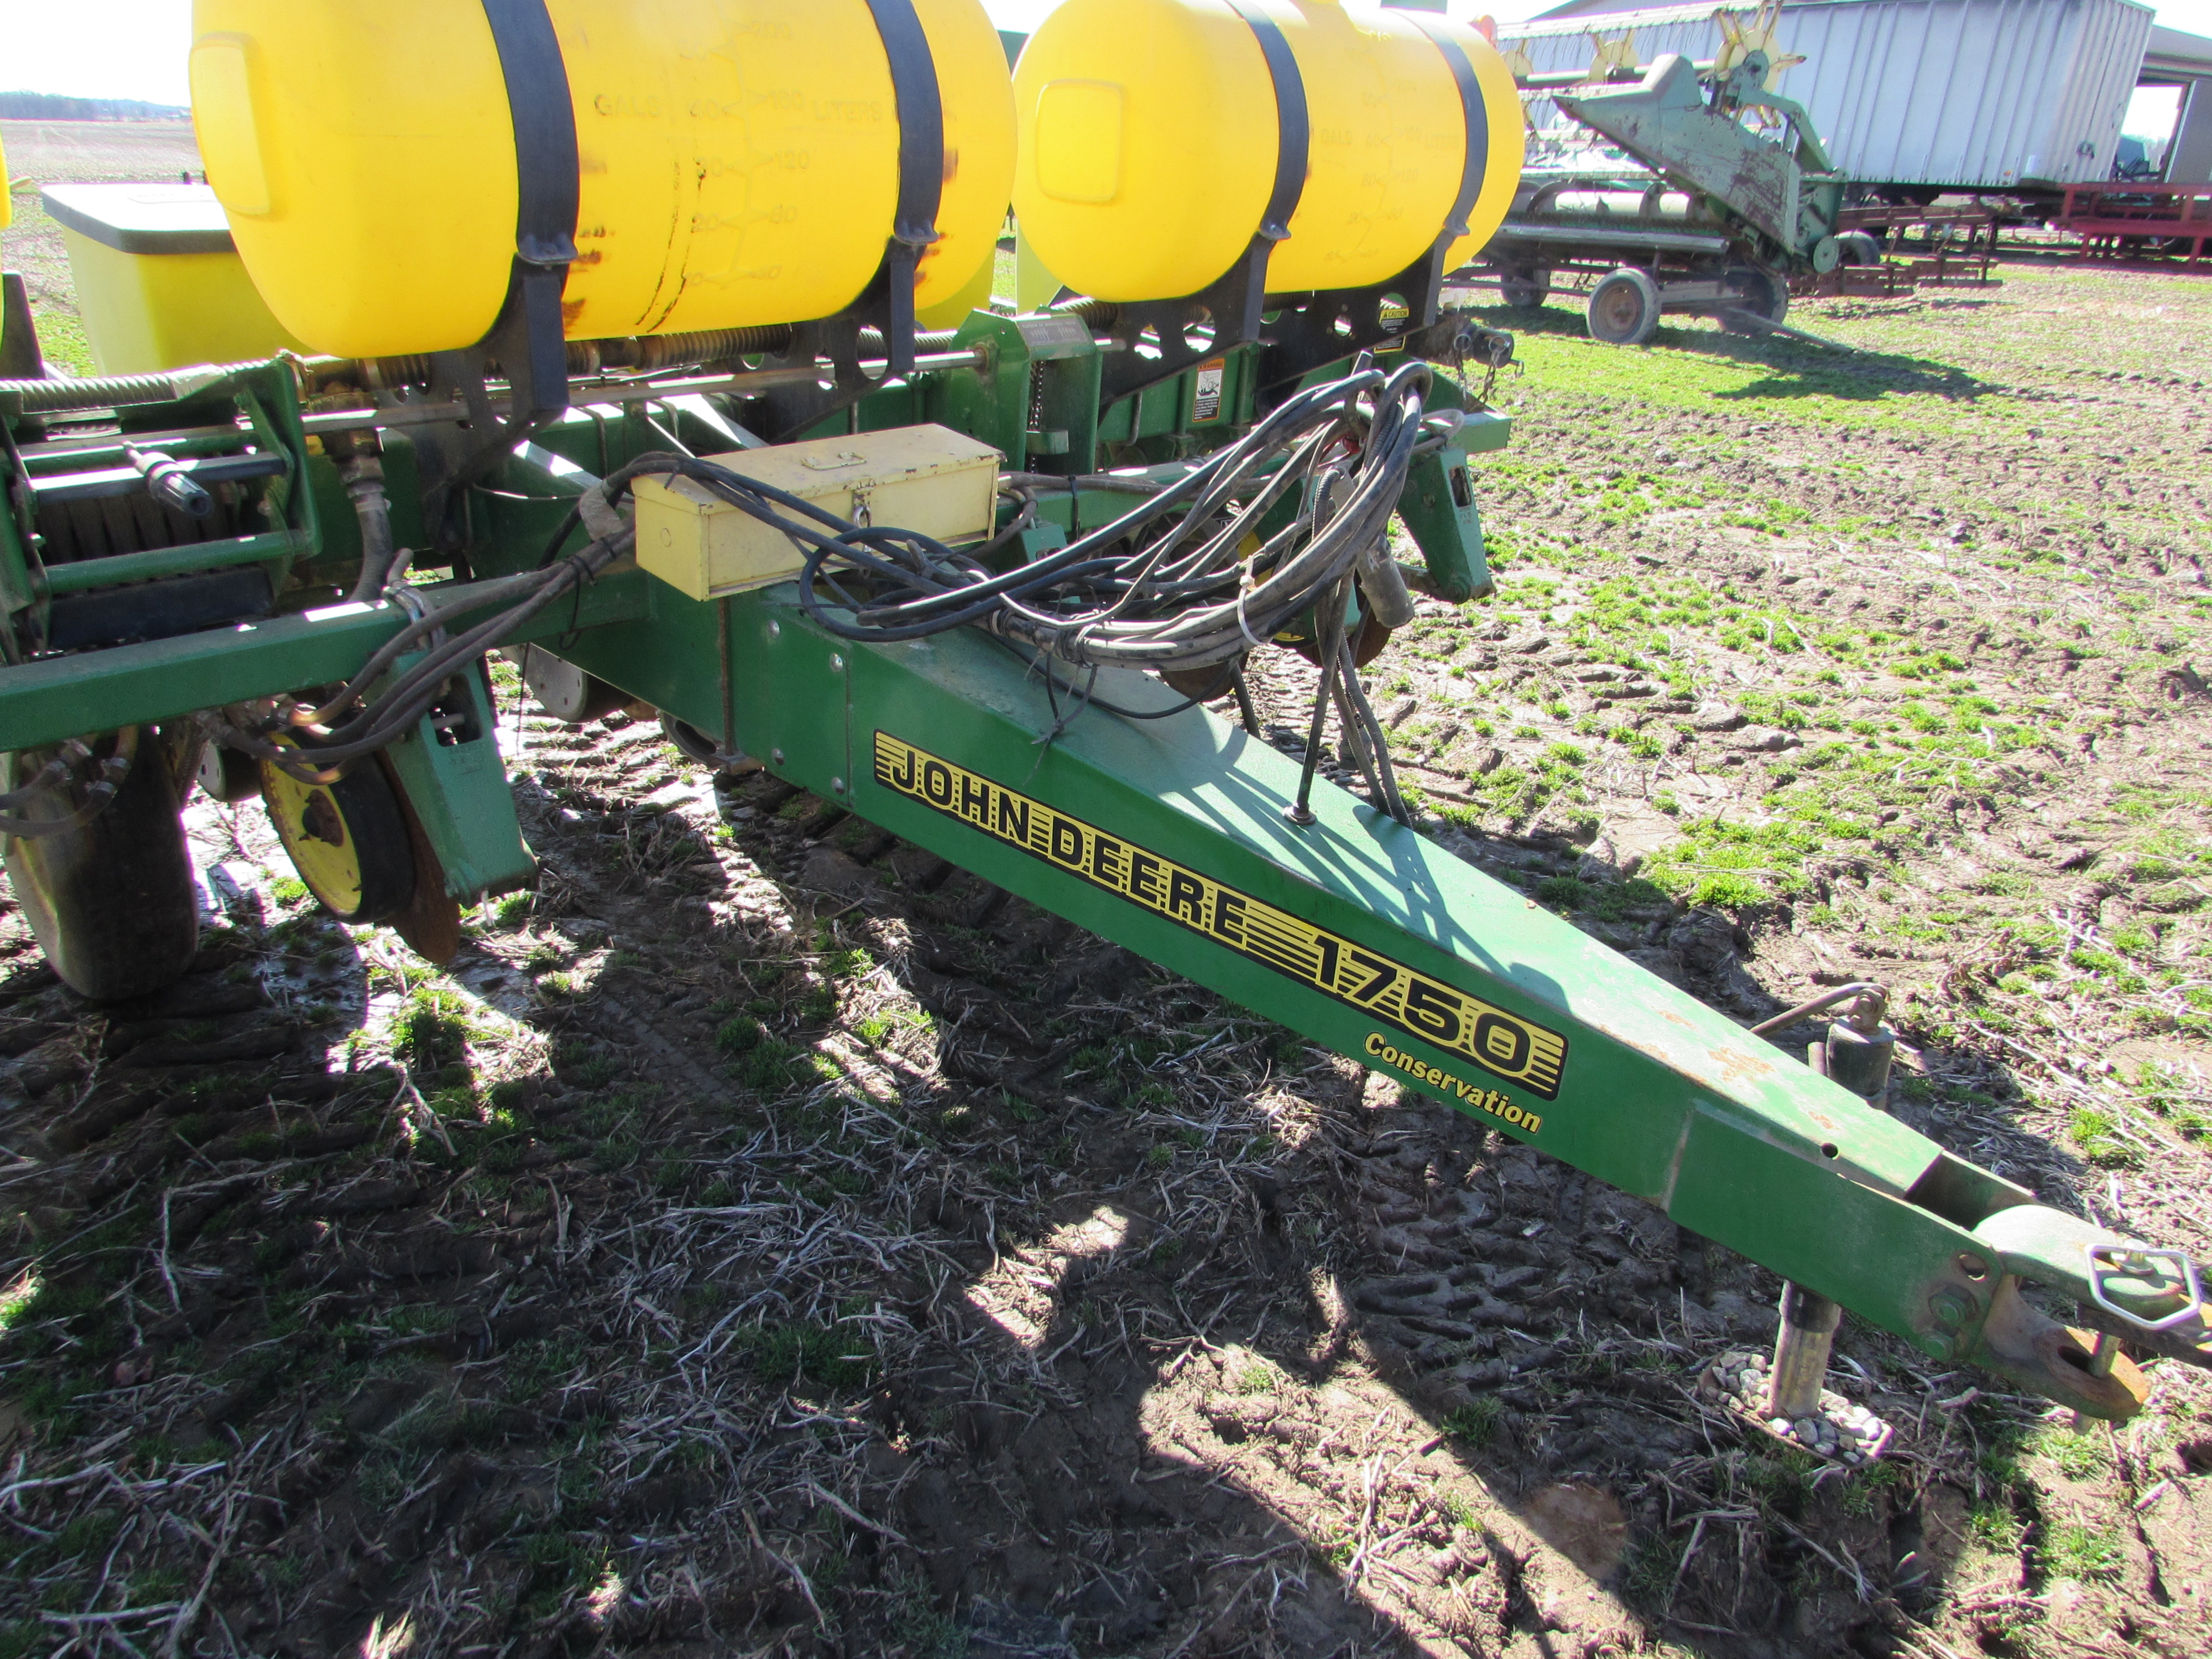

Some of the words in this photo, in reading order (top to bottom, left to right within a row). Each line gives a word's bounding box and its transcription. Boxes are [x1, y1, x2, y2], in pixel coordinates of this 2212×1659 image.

[594, 93, 662, 117] GALS
[690, 99, 718, 119] 40
[813, 100, 883, 121] LITERS
[774, 150, 810, 170] 120
[691, 213, 719, 233] 20
[889, 749, 1030, 845] JOHN
[1051, 814, 1247, 946] DEERE
[1314, 934, 1532, 1073] 1750
[1364, 1031, 1542, 1134] Conservation
